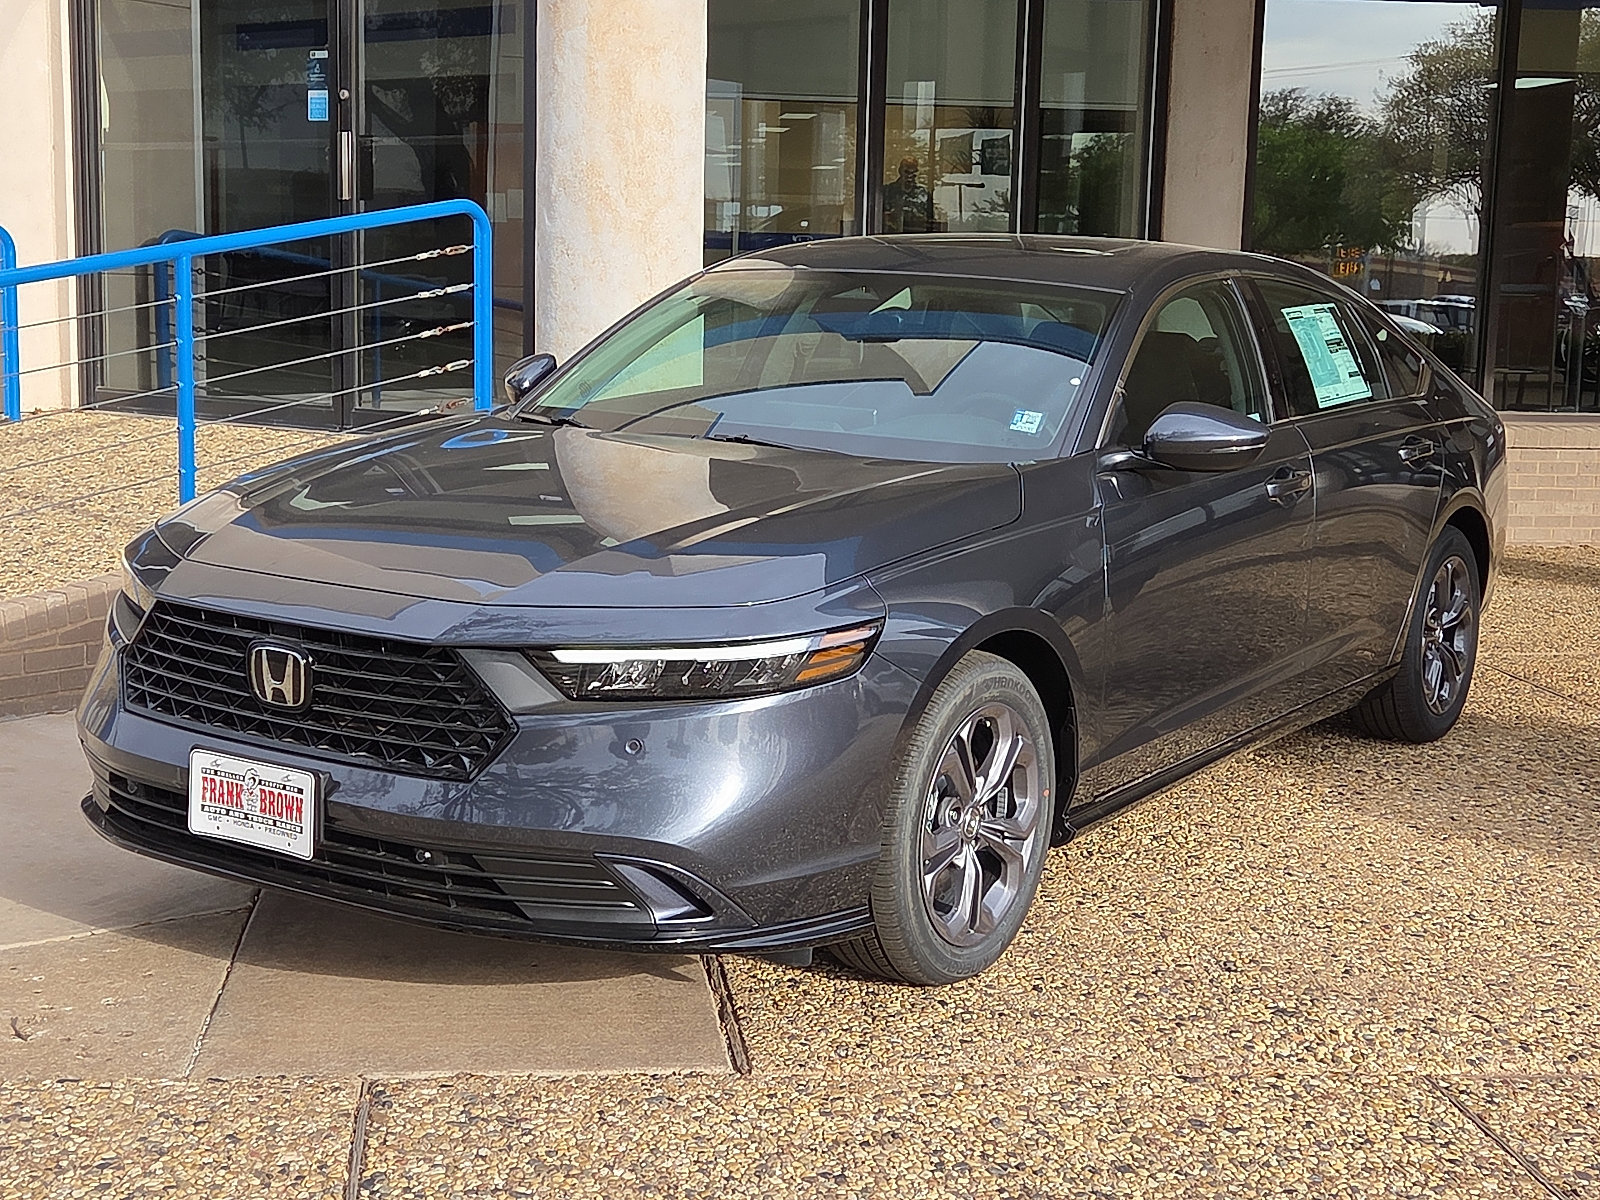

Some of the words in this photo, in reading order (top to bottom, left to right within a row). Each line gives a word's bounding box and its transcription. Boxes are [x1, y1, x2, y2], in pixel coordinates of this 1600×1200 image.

[202, 776, 244, 809] FRANK
[259, 788, 303, 824] BROWN
[203, 805, 226, 815] AUTO
[229, 811, 246, 819] AND
[248, 814, 274, 825] TRUCK
[275, 820, 302, 833] RANCH
[207, 815, 223, 823] GMC
